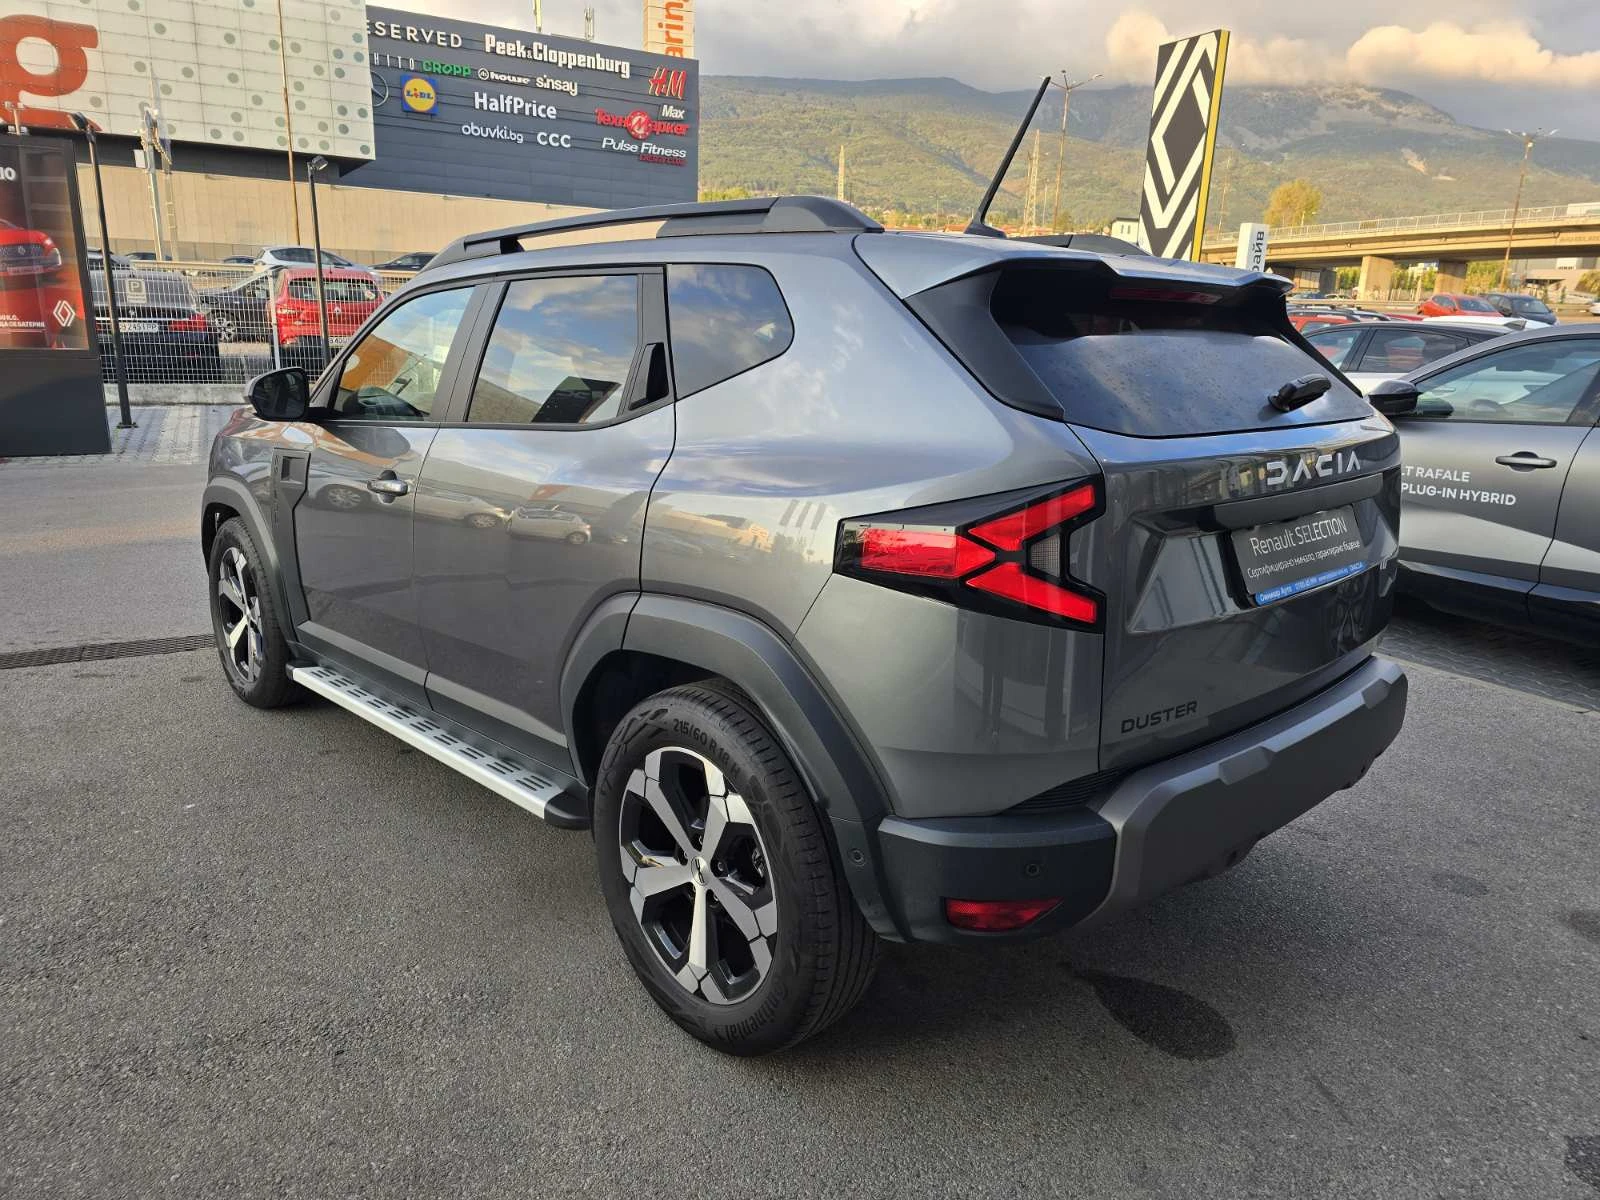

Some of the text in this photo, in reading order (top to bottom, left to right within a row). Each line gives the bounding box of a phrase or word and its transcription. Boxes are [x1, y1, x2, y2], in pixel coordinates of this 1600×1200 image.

[658, 0, 685, 58] arin
[422, 60, 472, 77] CROPP
[535, 74, 578, 97] sinsay
[648, 65, 687, 100] H&M
[474, 91, 557, 119] HalfPrice
[662, 104, 685, 119] Max
[461, 121, 524, 144] obuvki.bg
[536, 131, 571, 148] CCC
[602, 137, 687, 158] Pulse Fitness
[1266, 450, 1361, 487] DACIA
[1415, 467, 1471, 483] RAFALE
[1400, 482, 1517, 506] PLUG-IN HYBRID
[1250, 516, 1349, 556] Renault SELECTION
[1121, 700, 1198, 733] DUSTER
[673, 718, 708, 746] 215/60
